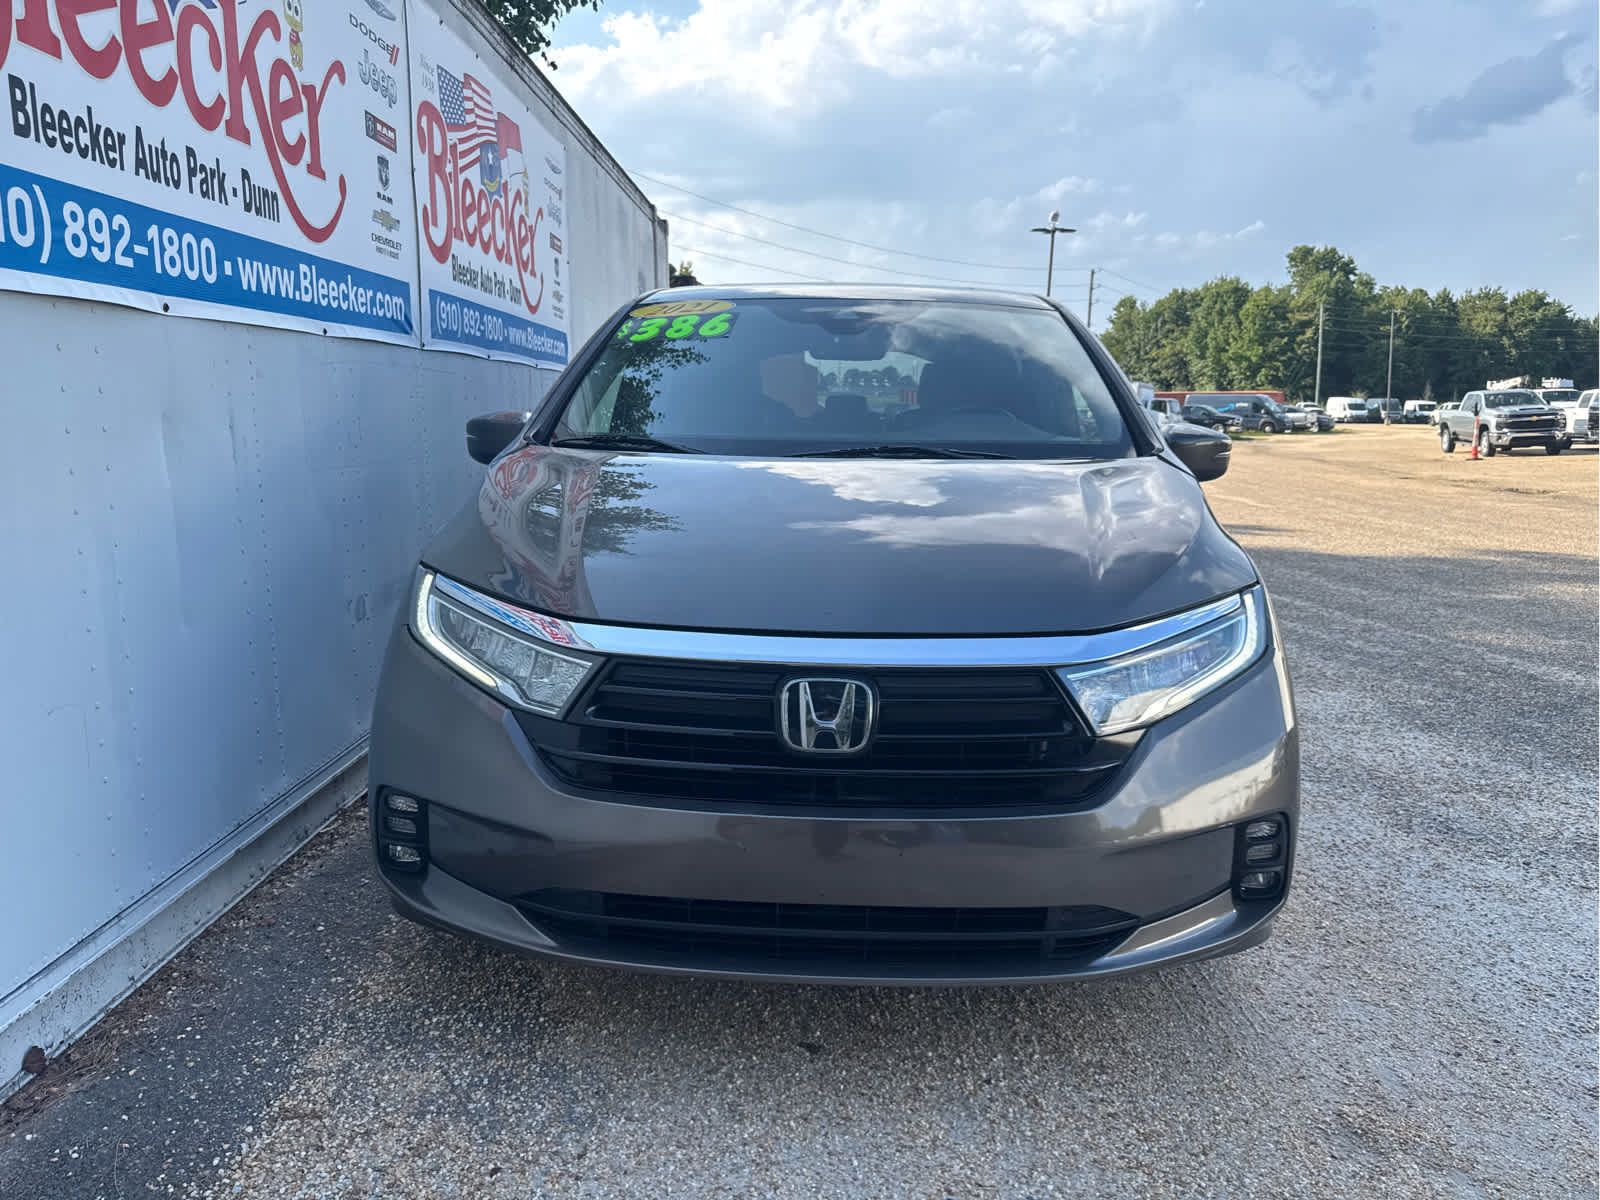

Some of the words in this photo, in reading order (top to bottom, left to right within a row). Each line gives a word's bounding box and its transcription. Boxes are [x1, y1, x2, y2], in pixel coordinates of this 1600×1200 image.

[349, 14, 394, 56] DODGE
[358, 48, 398, 109] Jeep
[0, 0, 347, 243] eecker
[8, 73, 126, 171] Bleecker
[134, 125, 181, 190] Auto
[185, 145, 229, 206] Park
[241, 168, 280, 223] Dunn
[376, 191, 393, 205] RAM
[417, 100, 544, 315] Bleecker
[63, 201, 218, 284] 892-1800
[237, 256, 405, 321] www.Bleecker.com
[371, 232, 402, 251] CHEVROLET
[452, 253, 479, 290] Bleecker
[480, 265, 494, 297] Auto
[494, 271, 507, 300] Park
[436, 295, 461, 338] (910)
[463, 307, 504, 342] 892-1800
[508, 326, 566, 357] www.Bleecker.com
[617, 312, 733, 342] $386
